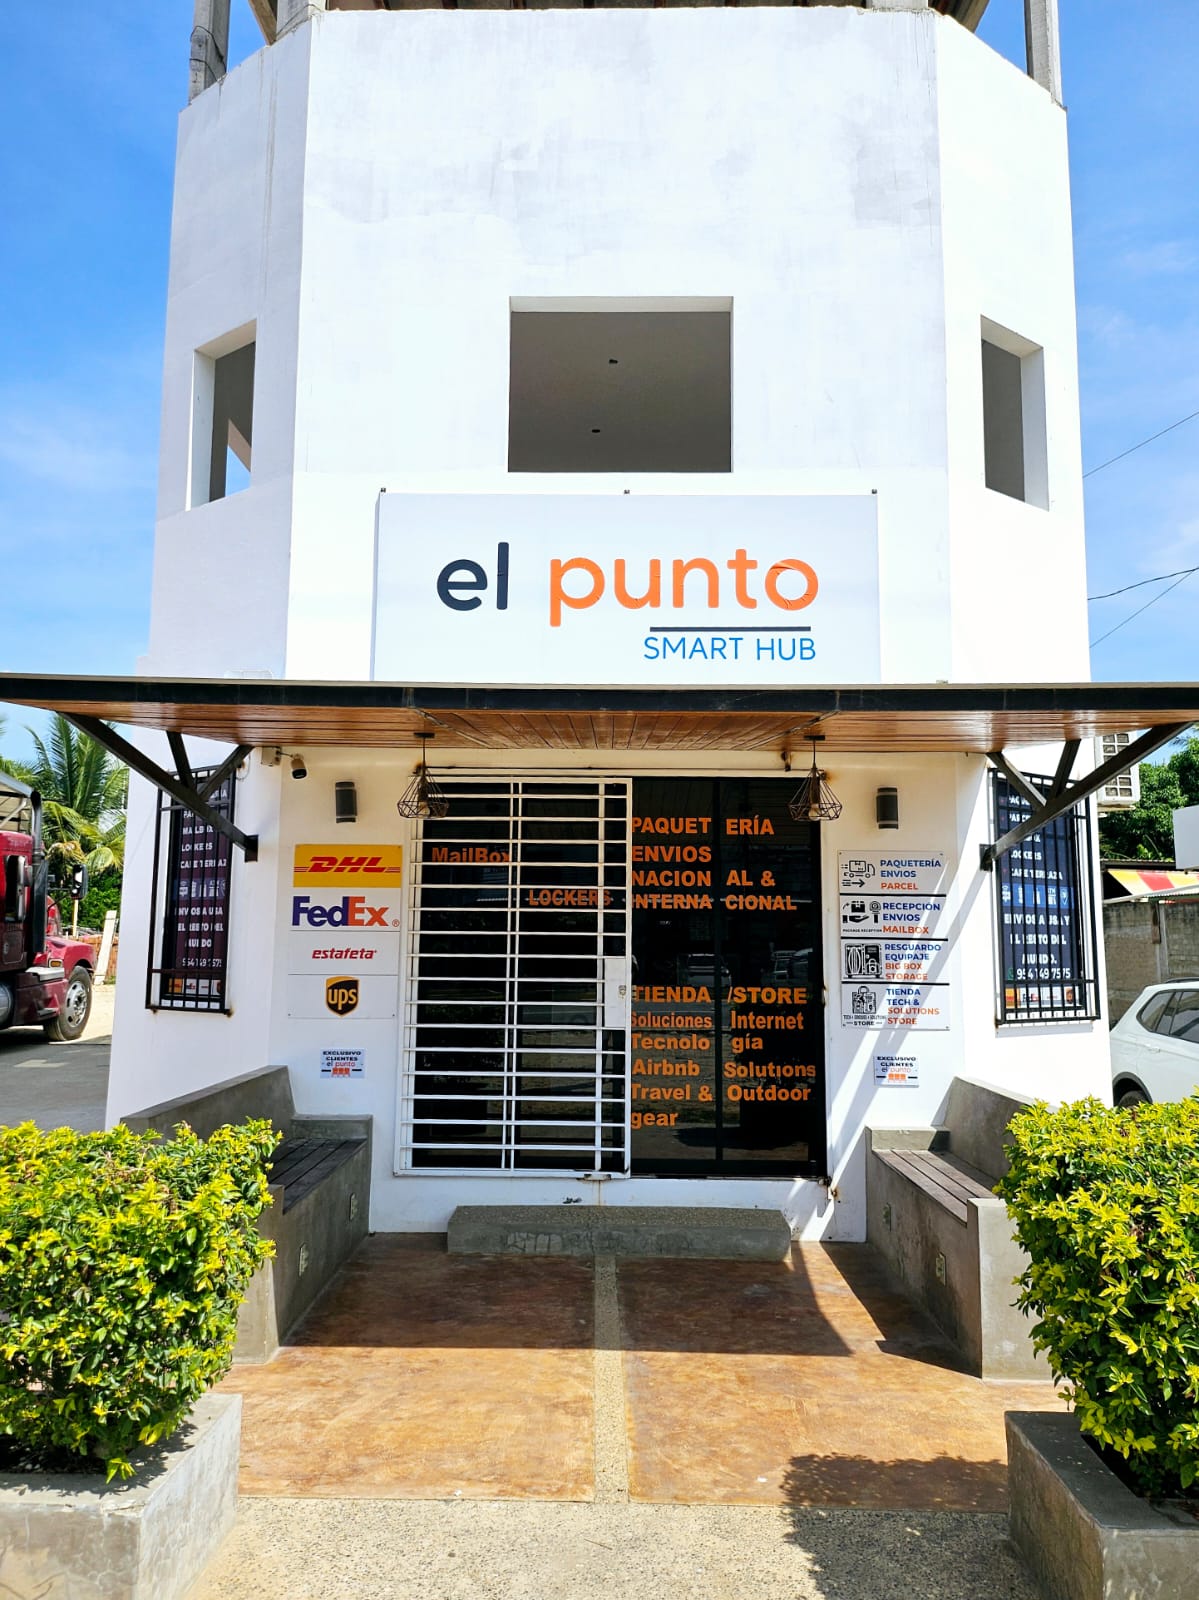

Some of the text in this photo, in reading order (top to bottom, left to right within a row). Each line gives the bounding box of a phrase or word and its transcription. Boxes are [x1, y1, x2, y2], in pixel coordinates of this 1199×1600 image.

[437, 542, 819, 627] el punto
[643, 637, 816, 661] SMART HUB
[726, 814, 775, 835] ERÍA
[632, 846, 712, 863] ENVIOS
[308, 856, 387, 873] DHL
[880, 858, 941, 869] PAQUETERÍA
[632, 870, 775, 887] NACION AL &
[880, 870, 916, 878] ENVIOS
[881, 882, 918, 891] PARCEL
[725, 894, 798, 911] CIONAL
[292, 895, 389, 928] FedEx
[882, 914, 920, 922] ENVIOS
[882, 926, 929, 934] MAILBOX
[312, 948, 377, 960] estafeta
[884, 943, 942, 952] RESGUARDO
[885, 953, 930, 962] EQUIPAJE
[903, 962, 922, 970] BOX
[885, 973, 928, 981] STORAGE
[328, 988, 357, 1010] ups
[886, 988, 921, 996] TIENDA
[888, 1007, 940, 1015] SOLUTIONS
[731, 1011, 804, 1030] Internet
[632, 1032, 764, 1054] Tecnolo gía
[632, 1058, 816, 1078] Airbnb Solutions
[632, 1083, 811, 1102] Travel & Outdoor
[631, 1112, 679, 1130] gear
